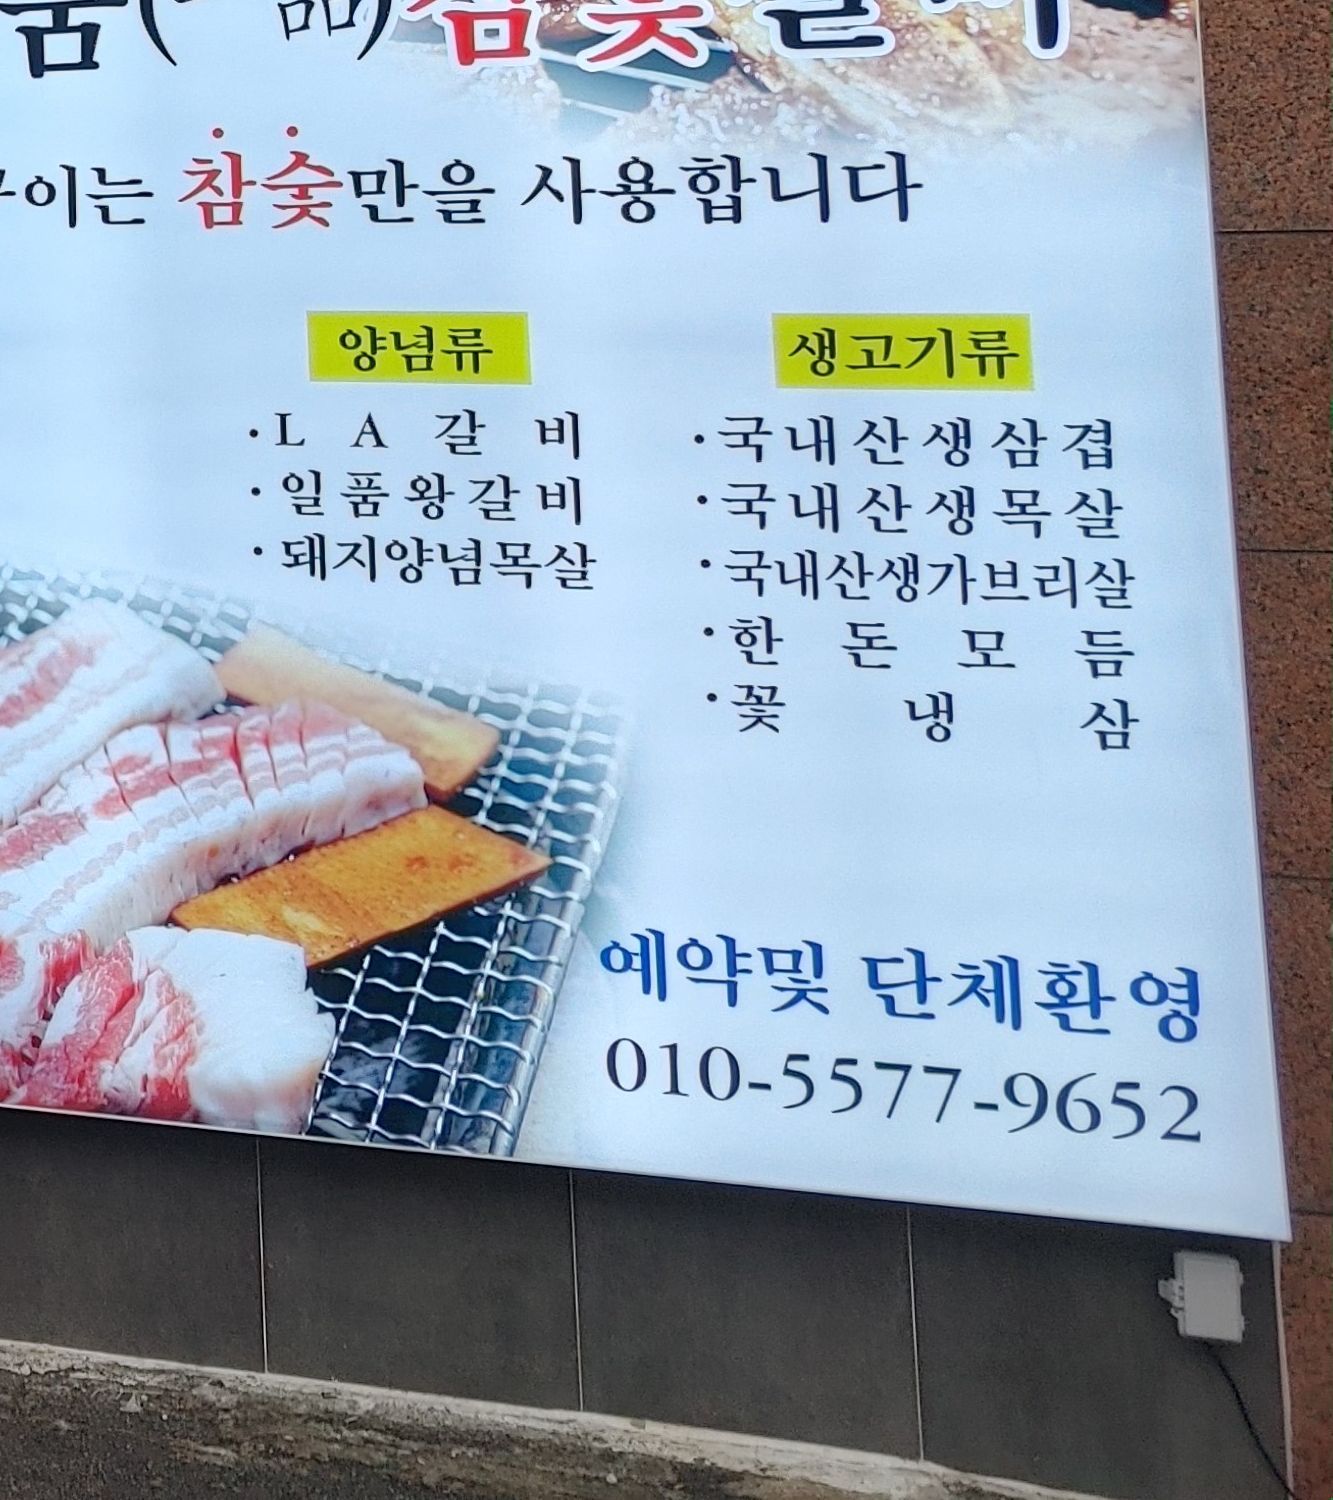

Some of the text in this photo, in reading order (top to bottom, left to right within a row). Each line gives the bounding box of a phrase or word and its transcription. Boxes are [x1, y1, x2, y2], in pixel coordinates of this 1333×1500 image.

[178, 150, 497, 230] 참숯만을
[521, 151, 924, 227] 사용합니다
[338, 325, 494, 378] 양념류
[789, 325, 1021, 380] 생고기류
[718, 413, 1114, 472] 국내산생삼겹
[281, 469, 583, 527] 일품왕갈비
[722, 483, 1124, 541] 국내산생목살
[280, 534, 598, 591] 돼지양념목살
[725, 548, 1136, 611] 국내산생가브리살
[599, 928, 1202, 1044] 예약및 단체환영
[606, 1036, 1203, 1143] 010-5577-9652
